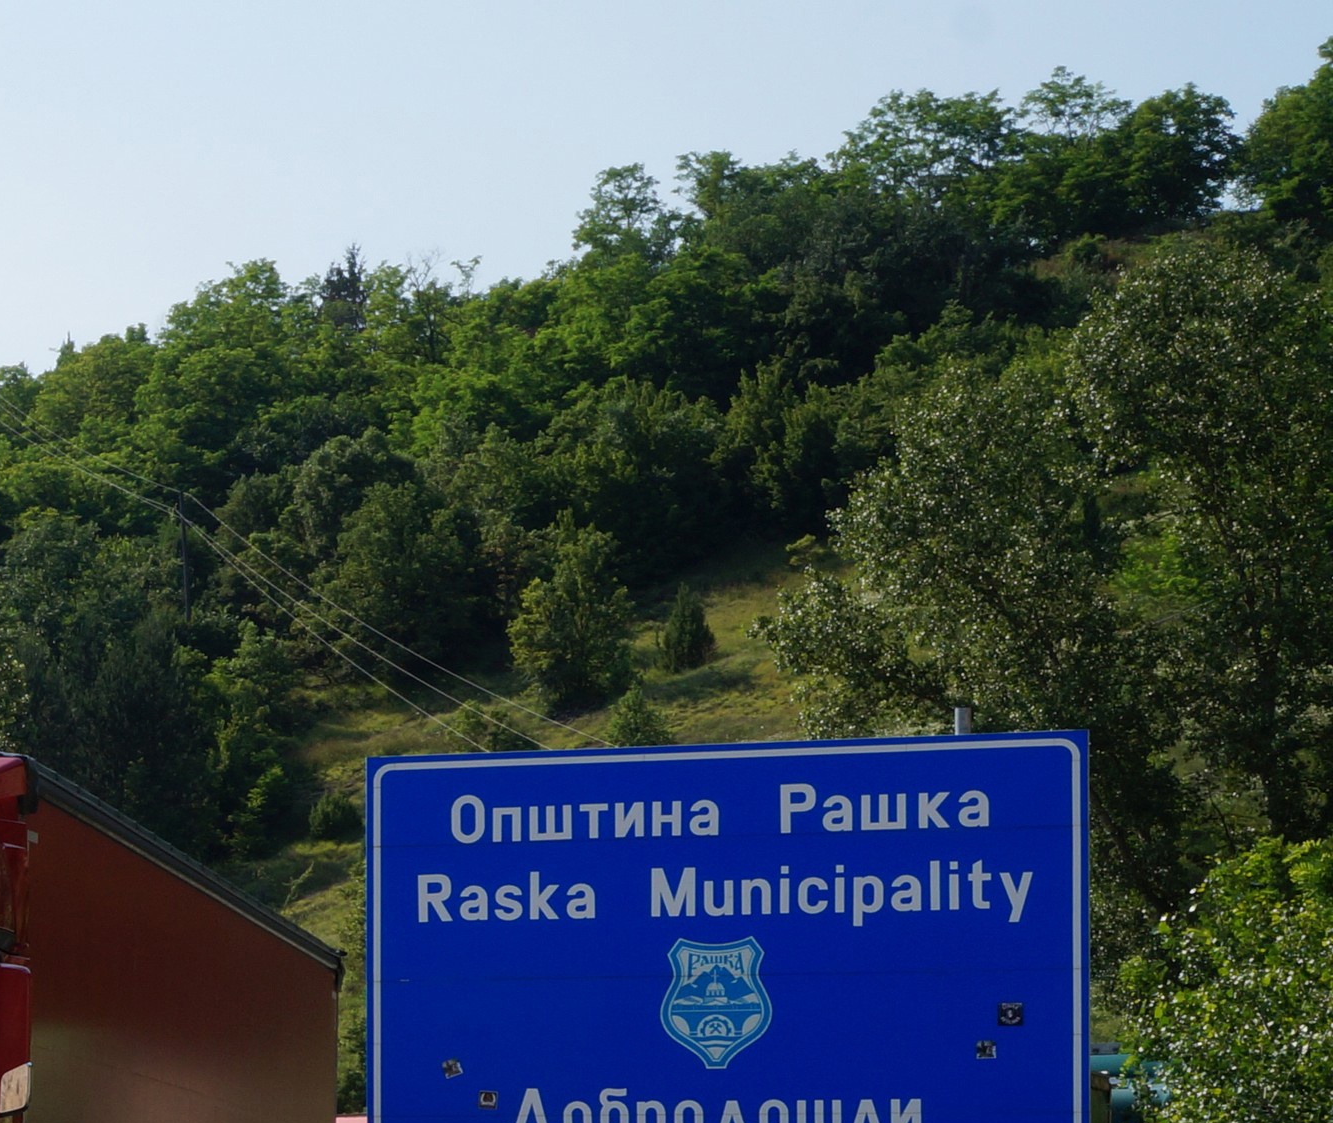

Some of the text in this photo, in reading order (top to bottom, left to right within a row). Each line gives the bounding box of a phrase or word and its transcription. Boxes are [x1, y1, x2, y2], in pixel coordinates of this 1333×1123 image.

[451, 783, 990, 844] Општина Рашка
[417, 860, 1033, 927] Raska Municipality
[687, 951, 745, 981] РАШКА
